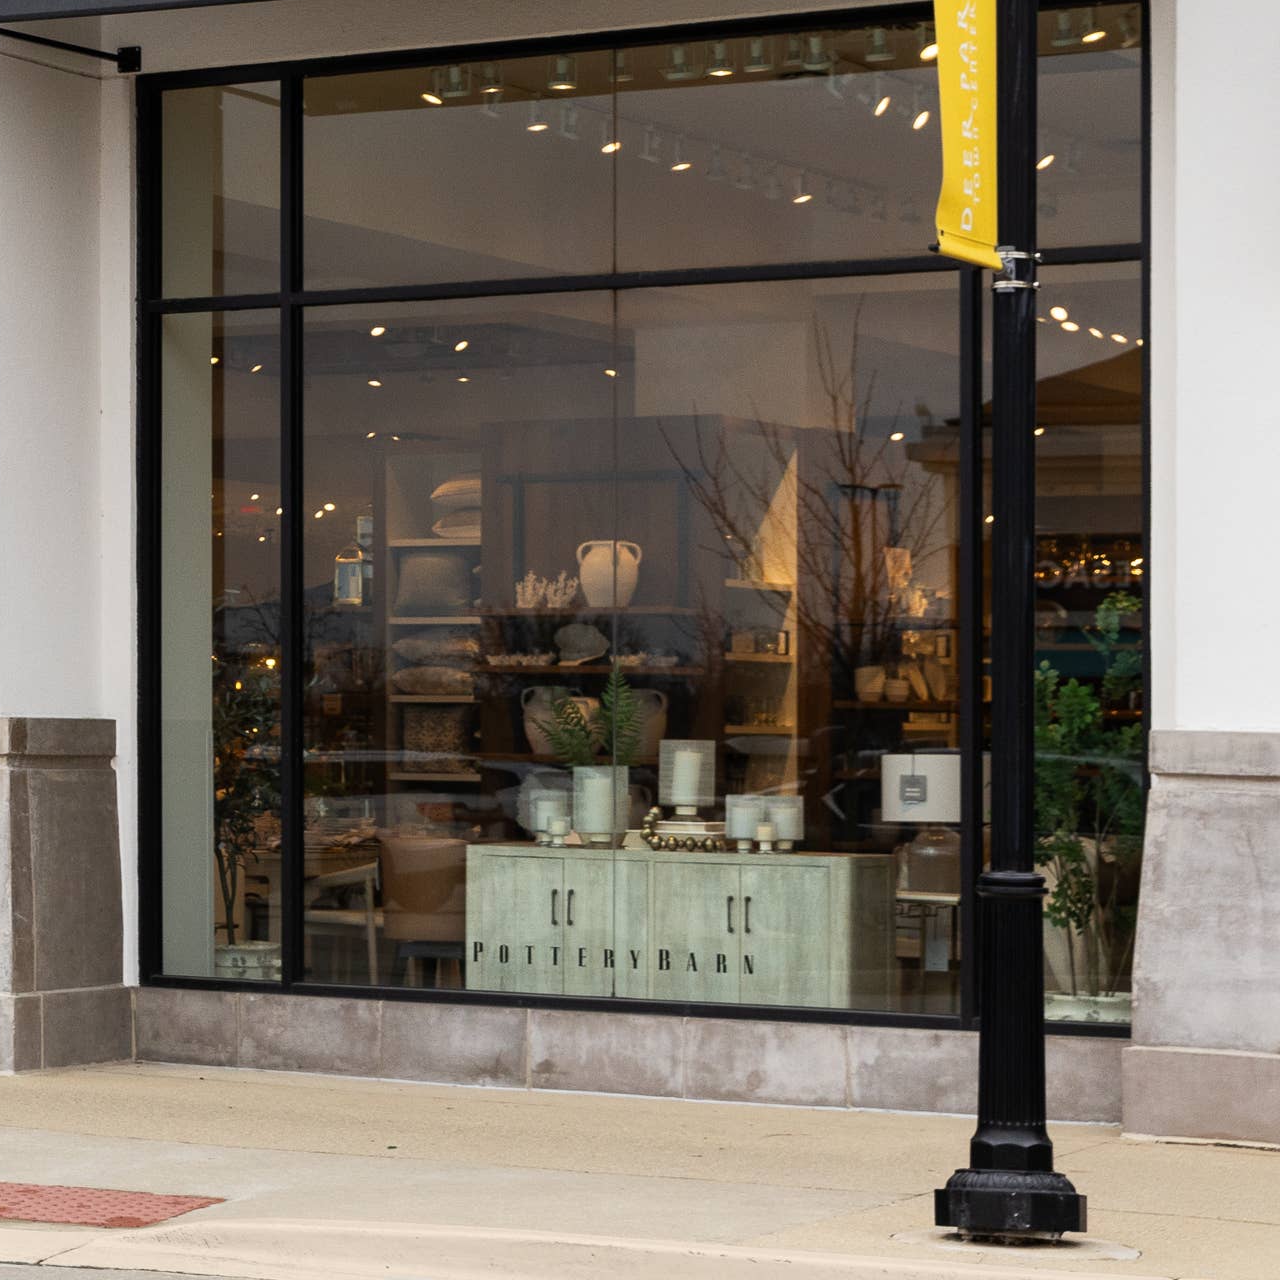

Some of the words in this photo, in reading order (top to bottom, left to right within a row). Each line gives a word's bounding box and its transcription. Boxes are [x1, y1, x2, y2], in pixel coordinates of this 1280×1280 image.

[961, 111, 974, 231] DEER
[473, 941, 641, 970] POTTERY
[658, 949, 755, 975] BARN
